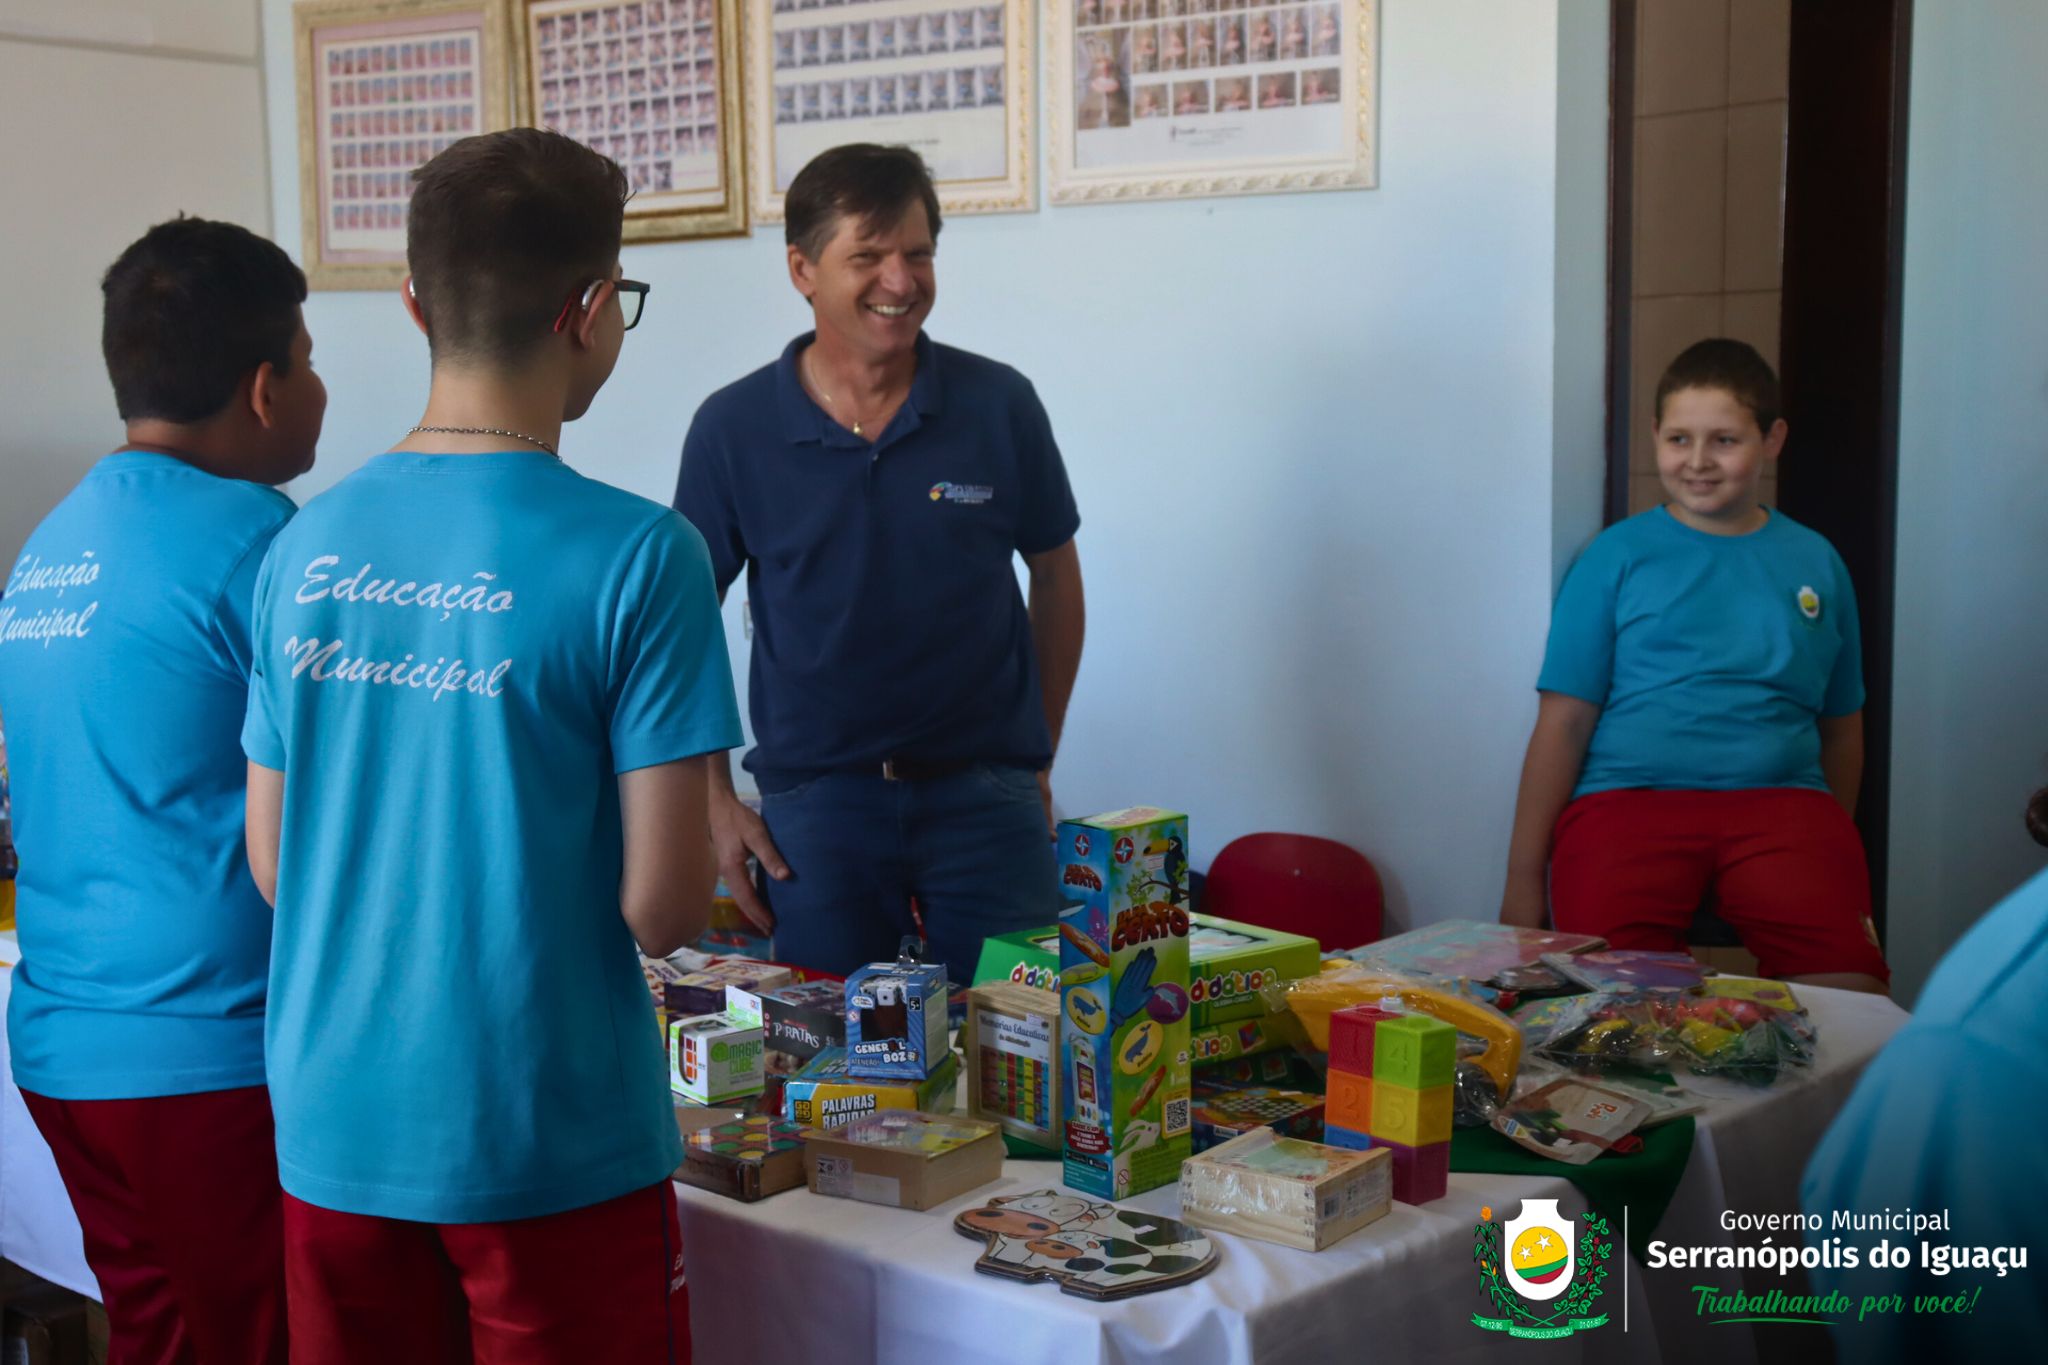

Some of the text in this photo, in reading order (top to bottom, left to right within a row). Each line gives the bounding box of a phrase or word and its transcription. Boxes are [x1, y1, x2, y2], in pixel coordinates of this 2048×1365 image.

[4, 551, 100, 598] Educação
[295, 555, 513, 621] Educação
[285, 635, 512, 702] Municipal
[821, 1093, 876, 1114] PALAVRAS
